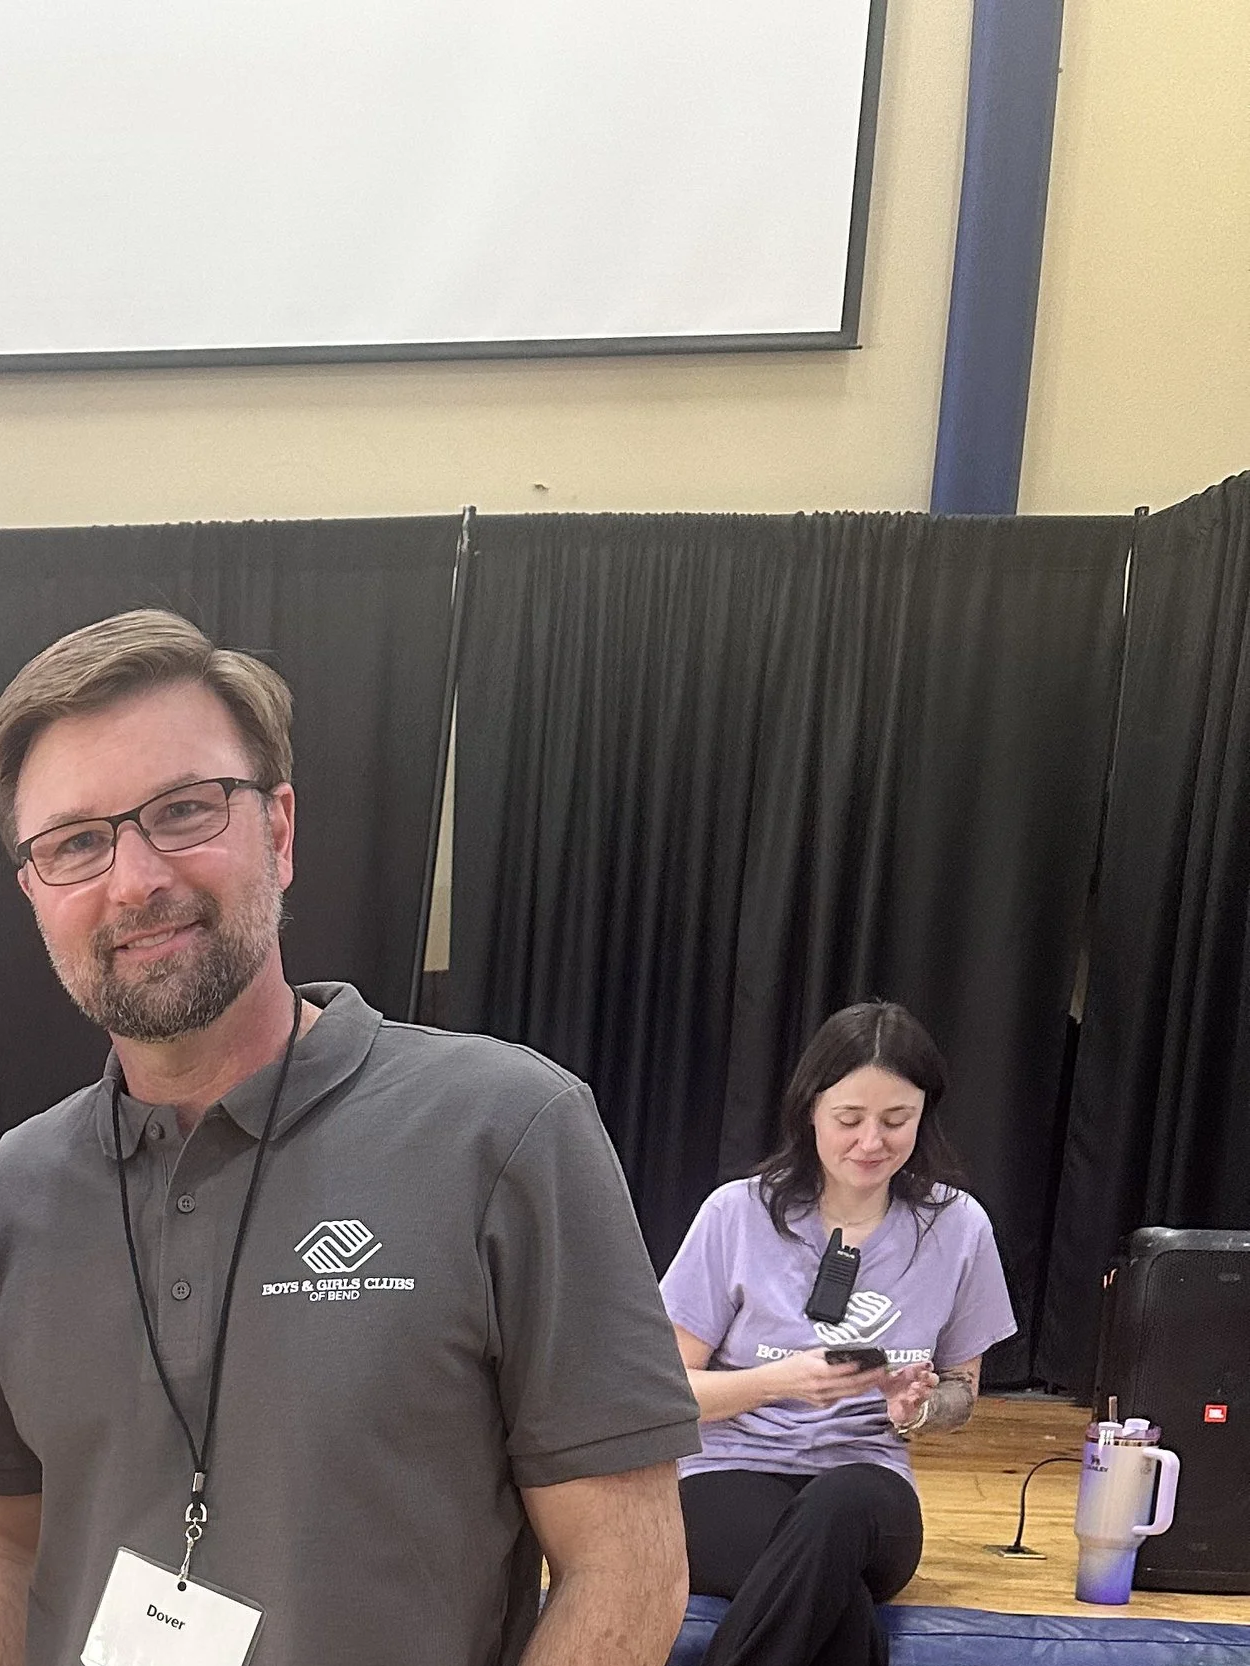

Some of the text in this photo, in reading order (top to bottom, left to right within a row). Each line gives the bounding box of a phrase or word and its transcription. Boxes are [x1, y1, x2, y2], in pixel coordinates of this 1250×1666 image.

[262, 1277, 415, 1295] BOYS & GIRLS CLUBS
[309, 1290, 360, 1302] OF BEND
[756, 1343, 798, 1360] BOY
[146, 1604, 186, 1630] Dover
